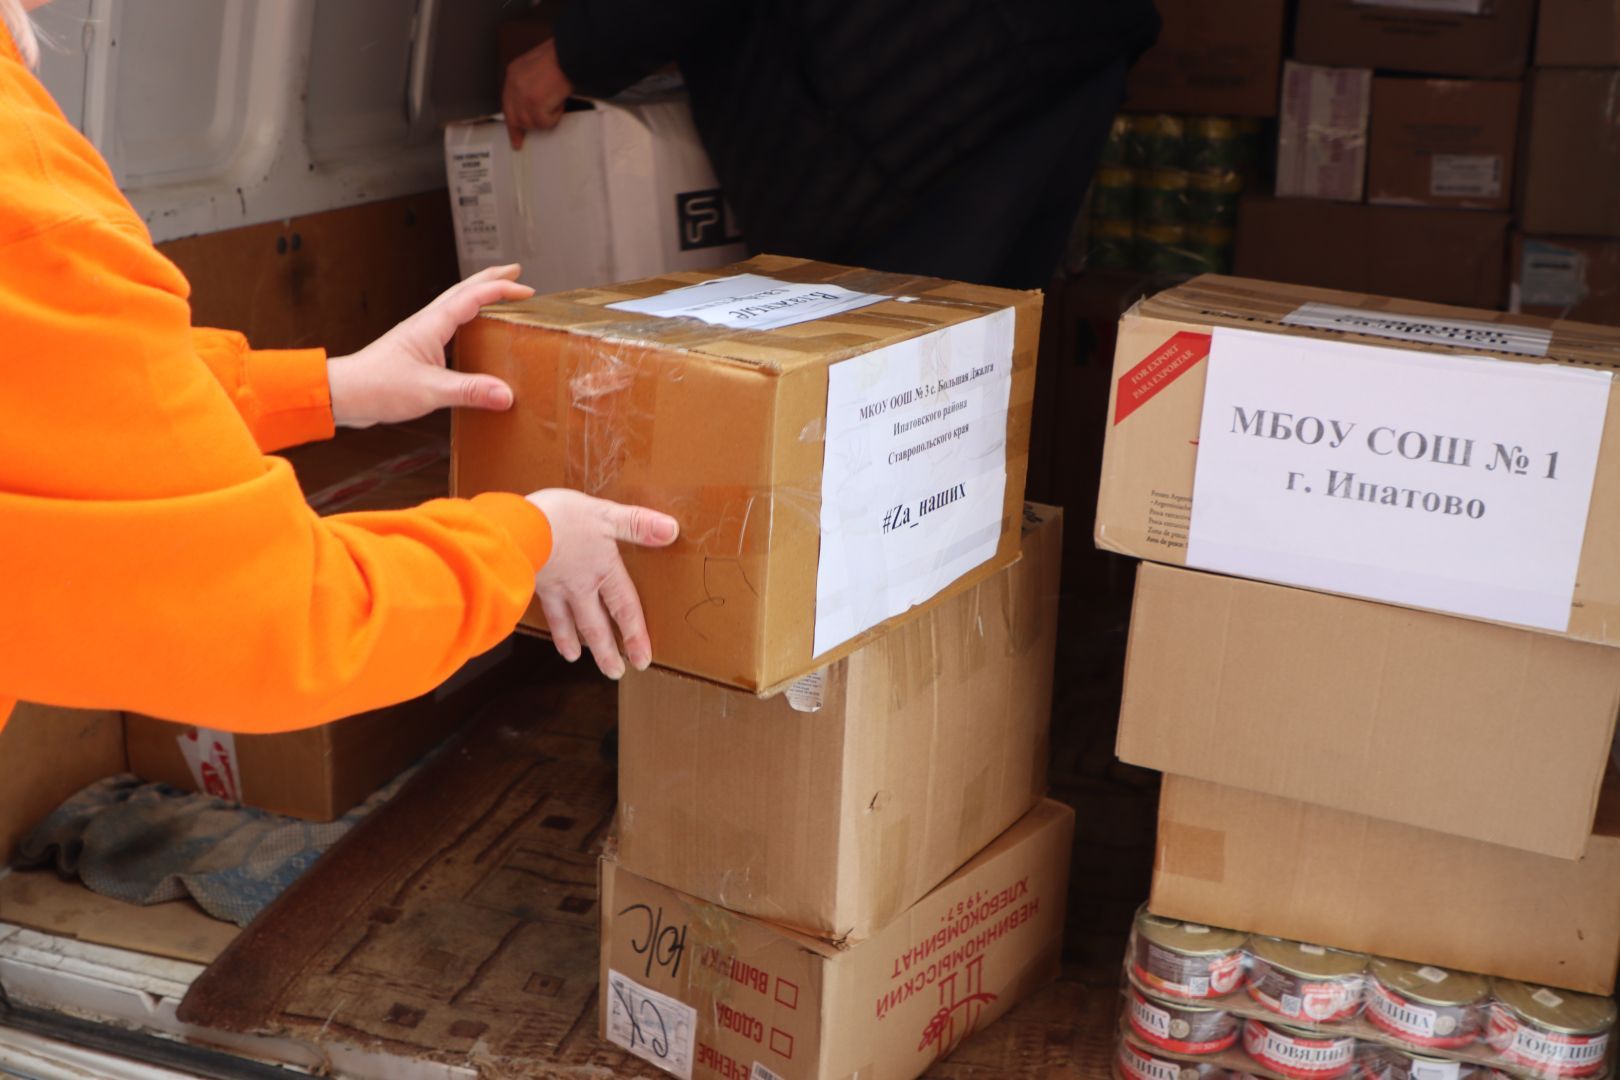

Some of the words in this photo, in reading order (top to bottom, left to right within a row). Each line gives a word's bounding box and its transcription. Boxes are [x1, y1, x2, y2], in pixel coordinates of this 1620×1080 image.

[1131, 368, 1149, 385] FOR
[1147, 343, 1179, 372] EXPORT
[1132, 381, 1155, 399] PARA
[1151, 349, 1194, 384] EXPORTAR
[859, 400, 889, 422] МКОУ
[890, 391, 913, 410] ООШ
[914, 387, 924, 401] №
[924, 385, 930, 398] 3
[937, 372, 969, 393] Большая
[970, 363, 994, 381] Джалга
[893, 410, 942, 436] Ипатовского
[942, 399, 968, 420] района
[888, 430, 952, 465] Ставропольского
[953, 423, 969, 441] края
[1229, 405, 1357, 448] МБОУ
[1366, 425, 1476, 468] СОШ
[1484, 442, 1530, 475] №
[1543, 451, 1560, 480] 1
[882, 482, 966, 535] #Za_наших
[1285, 470, 1312, 494] г.
[1325, 468, 1486, 520] Ипатово
[891, 875, 1028, 979] ХЛЕБОКОМБИНАТ
[876, 897, 1039, 1020] НЕВИННОМЫССКИЙ
